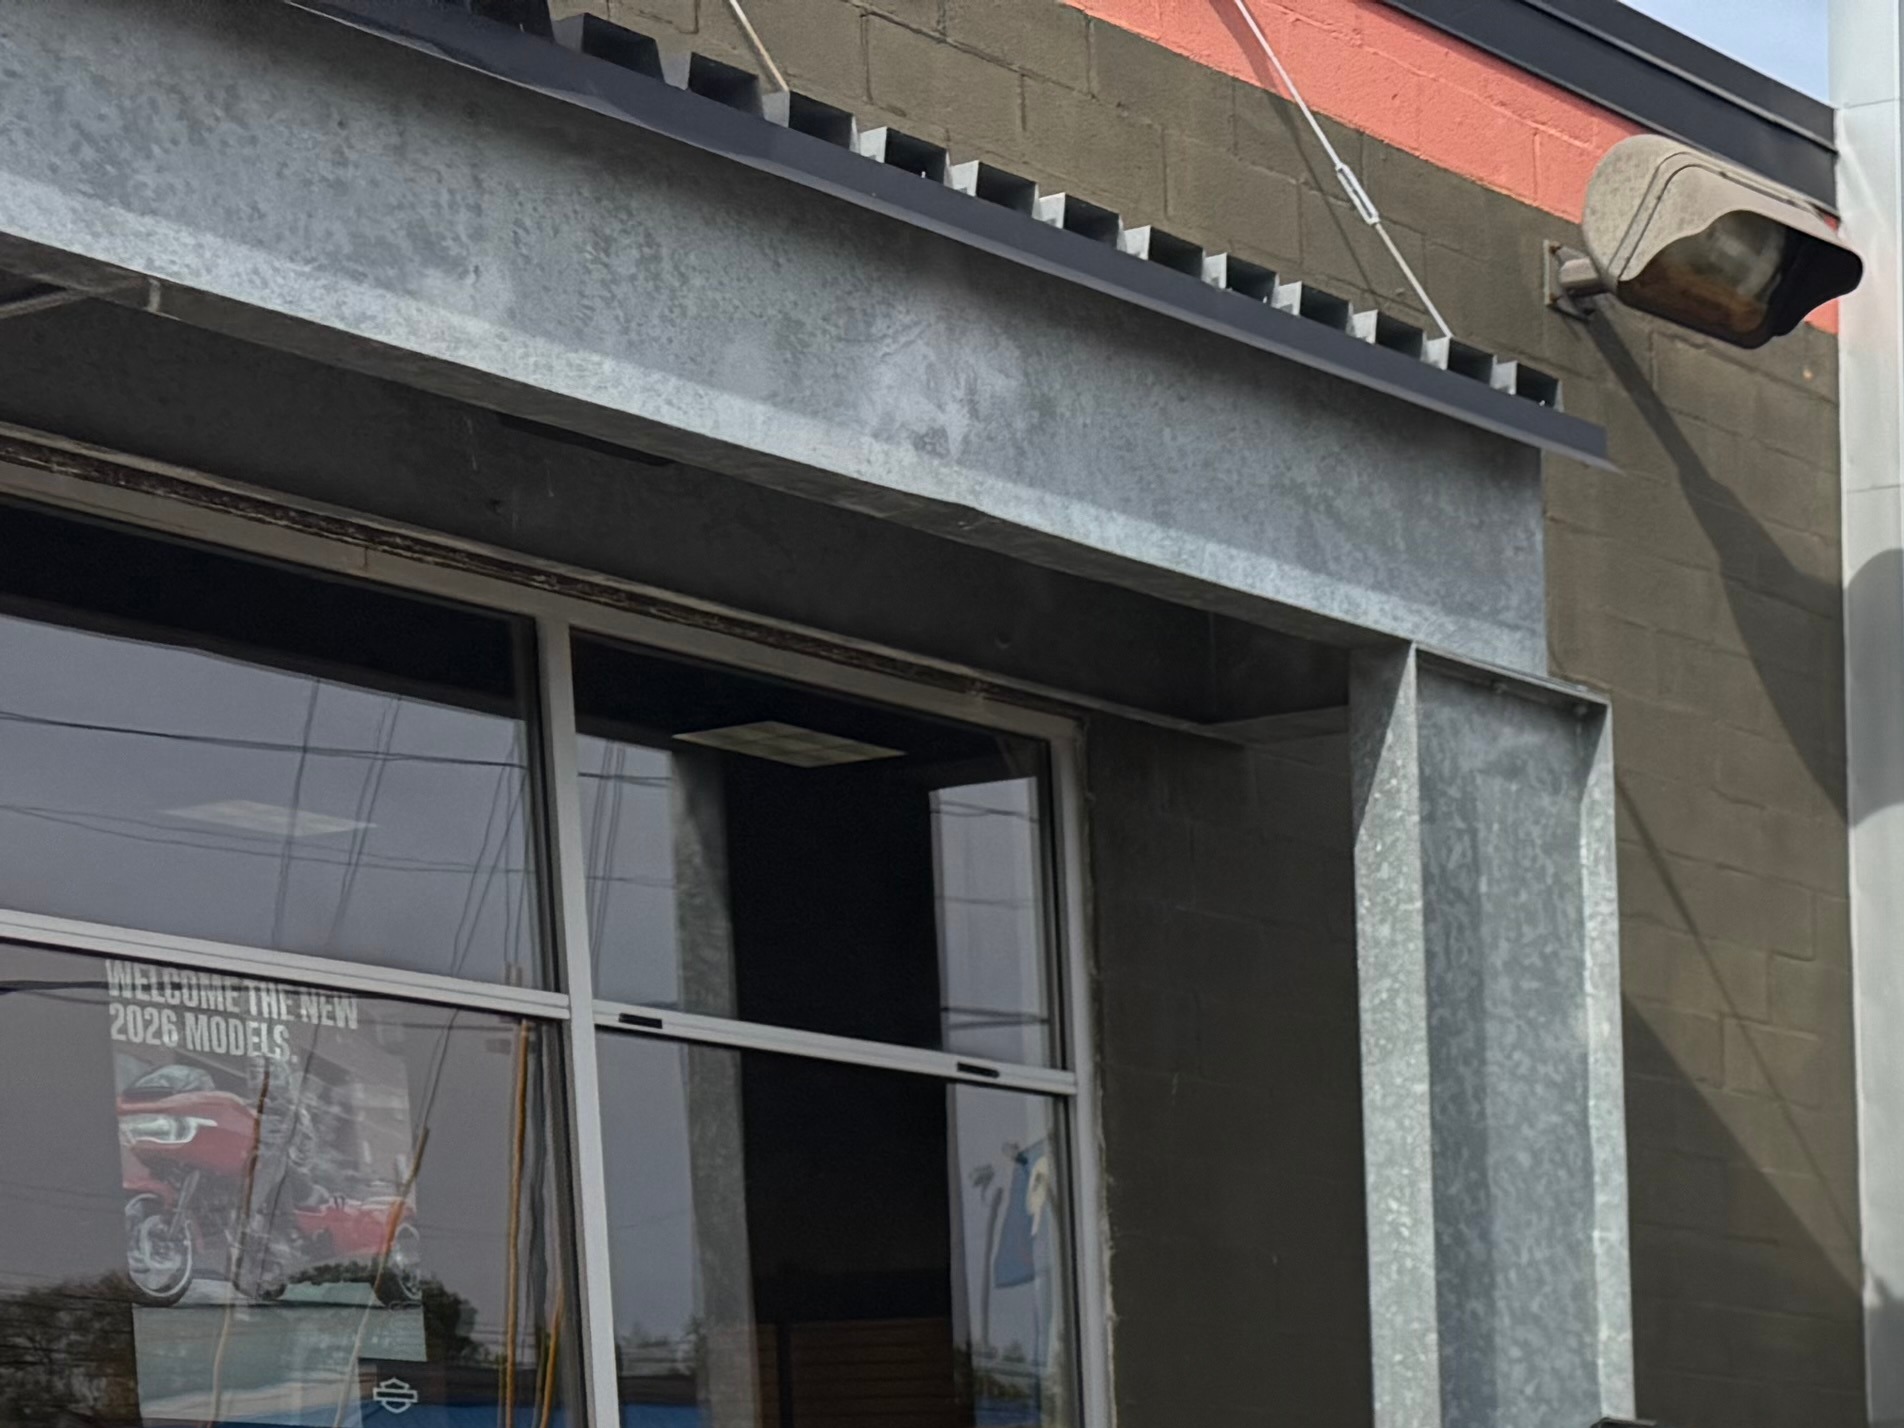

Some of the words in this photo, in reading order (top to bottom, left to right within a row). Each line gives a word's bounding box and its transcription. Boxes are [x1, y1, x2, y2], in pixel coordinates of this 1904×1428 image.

[105, 958, 240, 1014] WELCOME
[249, 979, 295, 1022] THE
[300, 991, 358, 1030] NEW
[109, 1002, 179, 1048] 2026
[184, 1011, 298, 1064] MODELS.
